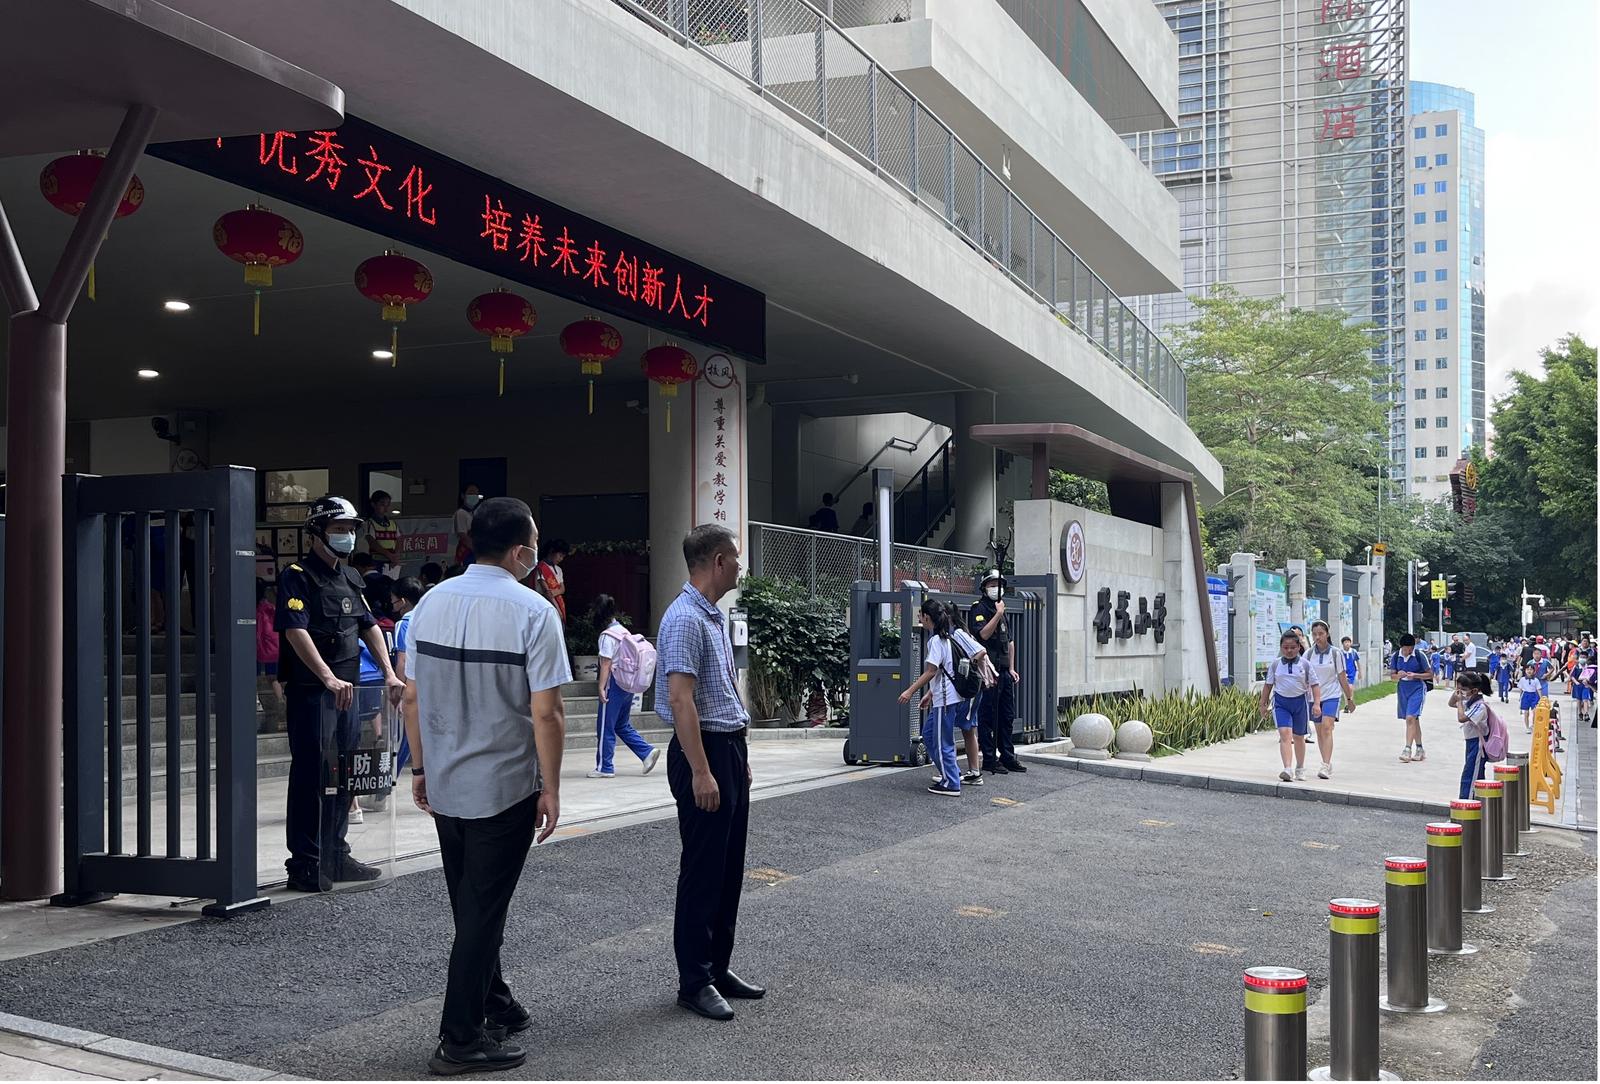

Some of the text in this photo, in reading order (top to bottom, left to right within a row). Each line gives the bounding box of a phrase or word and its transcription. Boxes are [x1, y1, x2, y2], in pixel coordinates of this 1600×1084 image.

[217, 130, 714, 327] 优秀文化 培养未来创新人才
[353, 752, 391, 776] 防暴
[347, 774, 393, 791] FANG BAO
